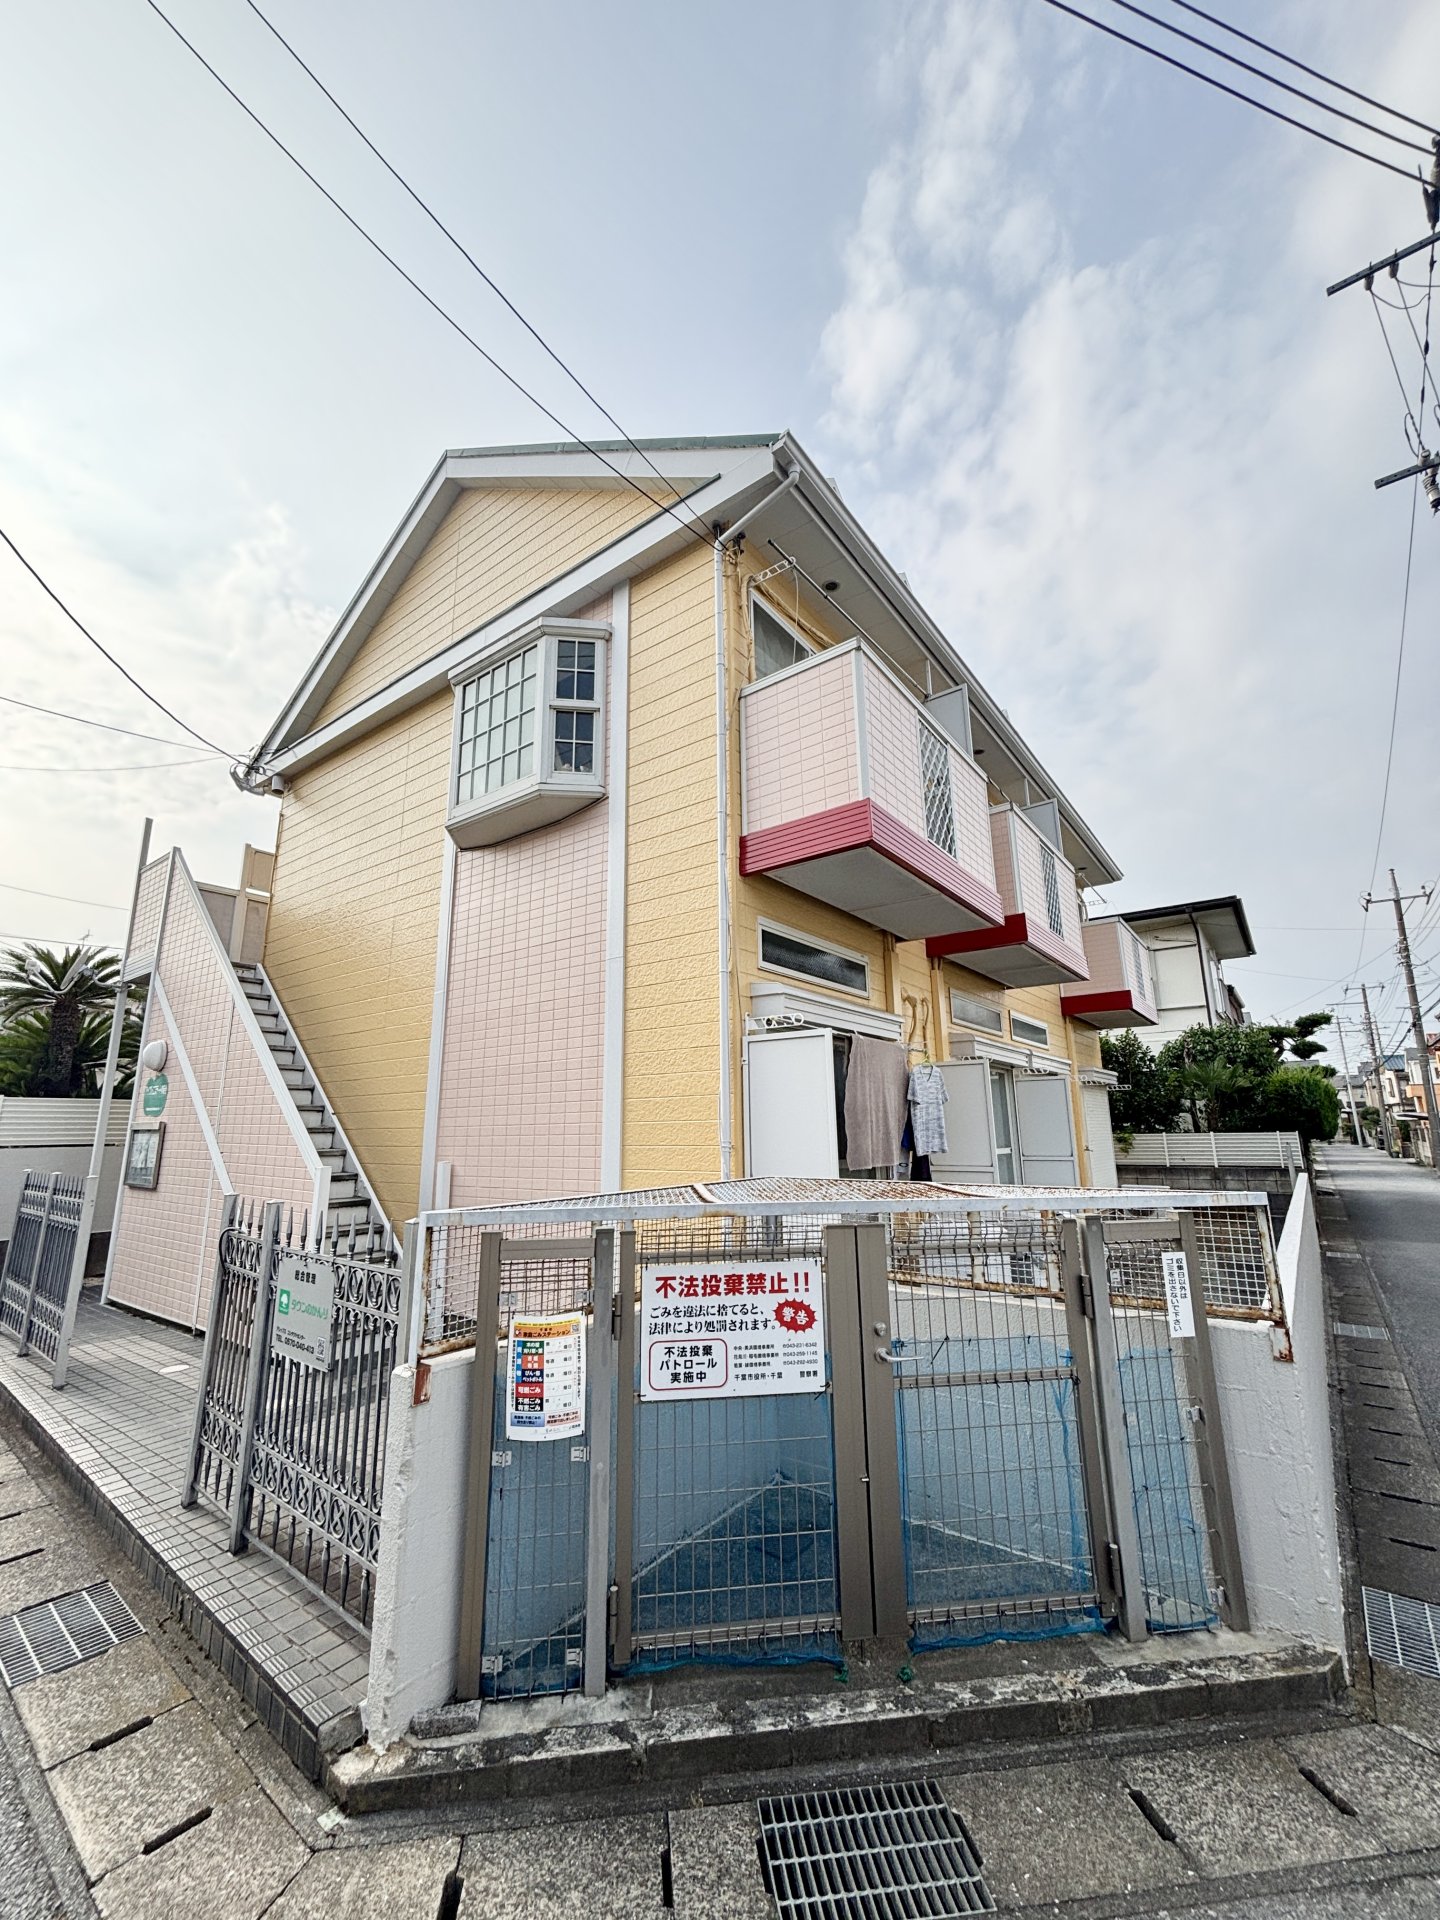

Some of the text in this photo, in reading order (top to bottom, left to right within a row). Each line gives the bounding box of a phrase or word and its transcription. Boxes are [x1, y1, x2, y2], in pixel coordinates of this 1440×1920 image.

[1176, 1258, 1188, 1299] 収集日以外は
[1166, 1258, 1182, 1331] ゴミを出さないで下さい
[650, 1303, 764, 1318] ごみを違法に捨てると、
[781, 1306, 809, 1324] 警告
[648, 1319, 775, 1335] 法律により処罰されます。
[664, 1345, 713, 1358] 不法投棄
[659, 1359, 717, 1371] パトロール
[670, 1372, 707, 1383] 実施中
